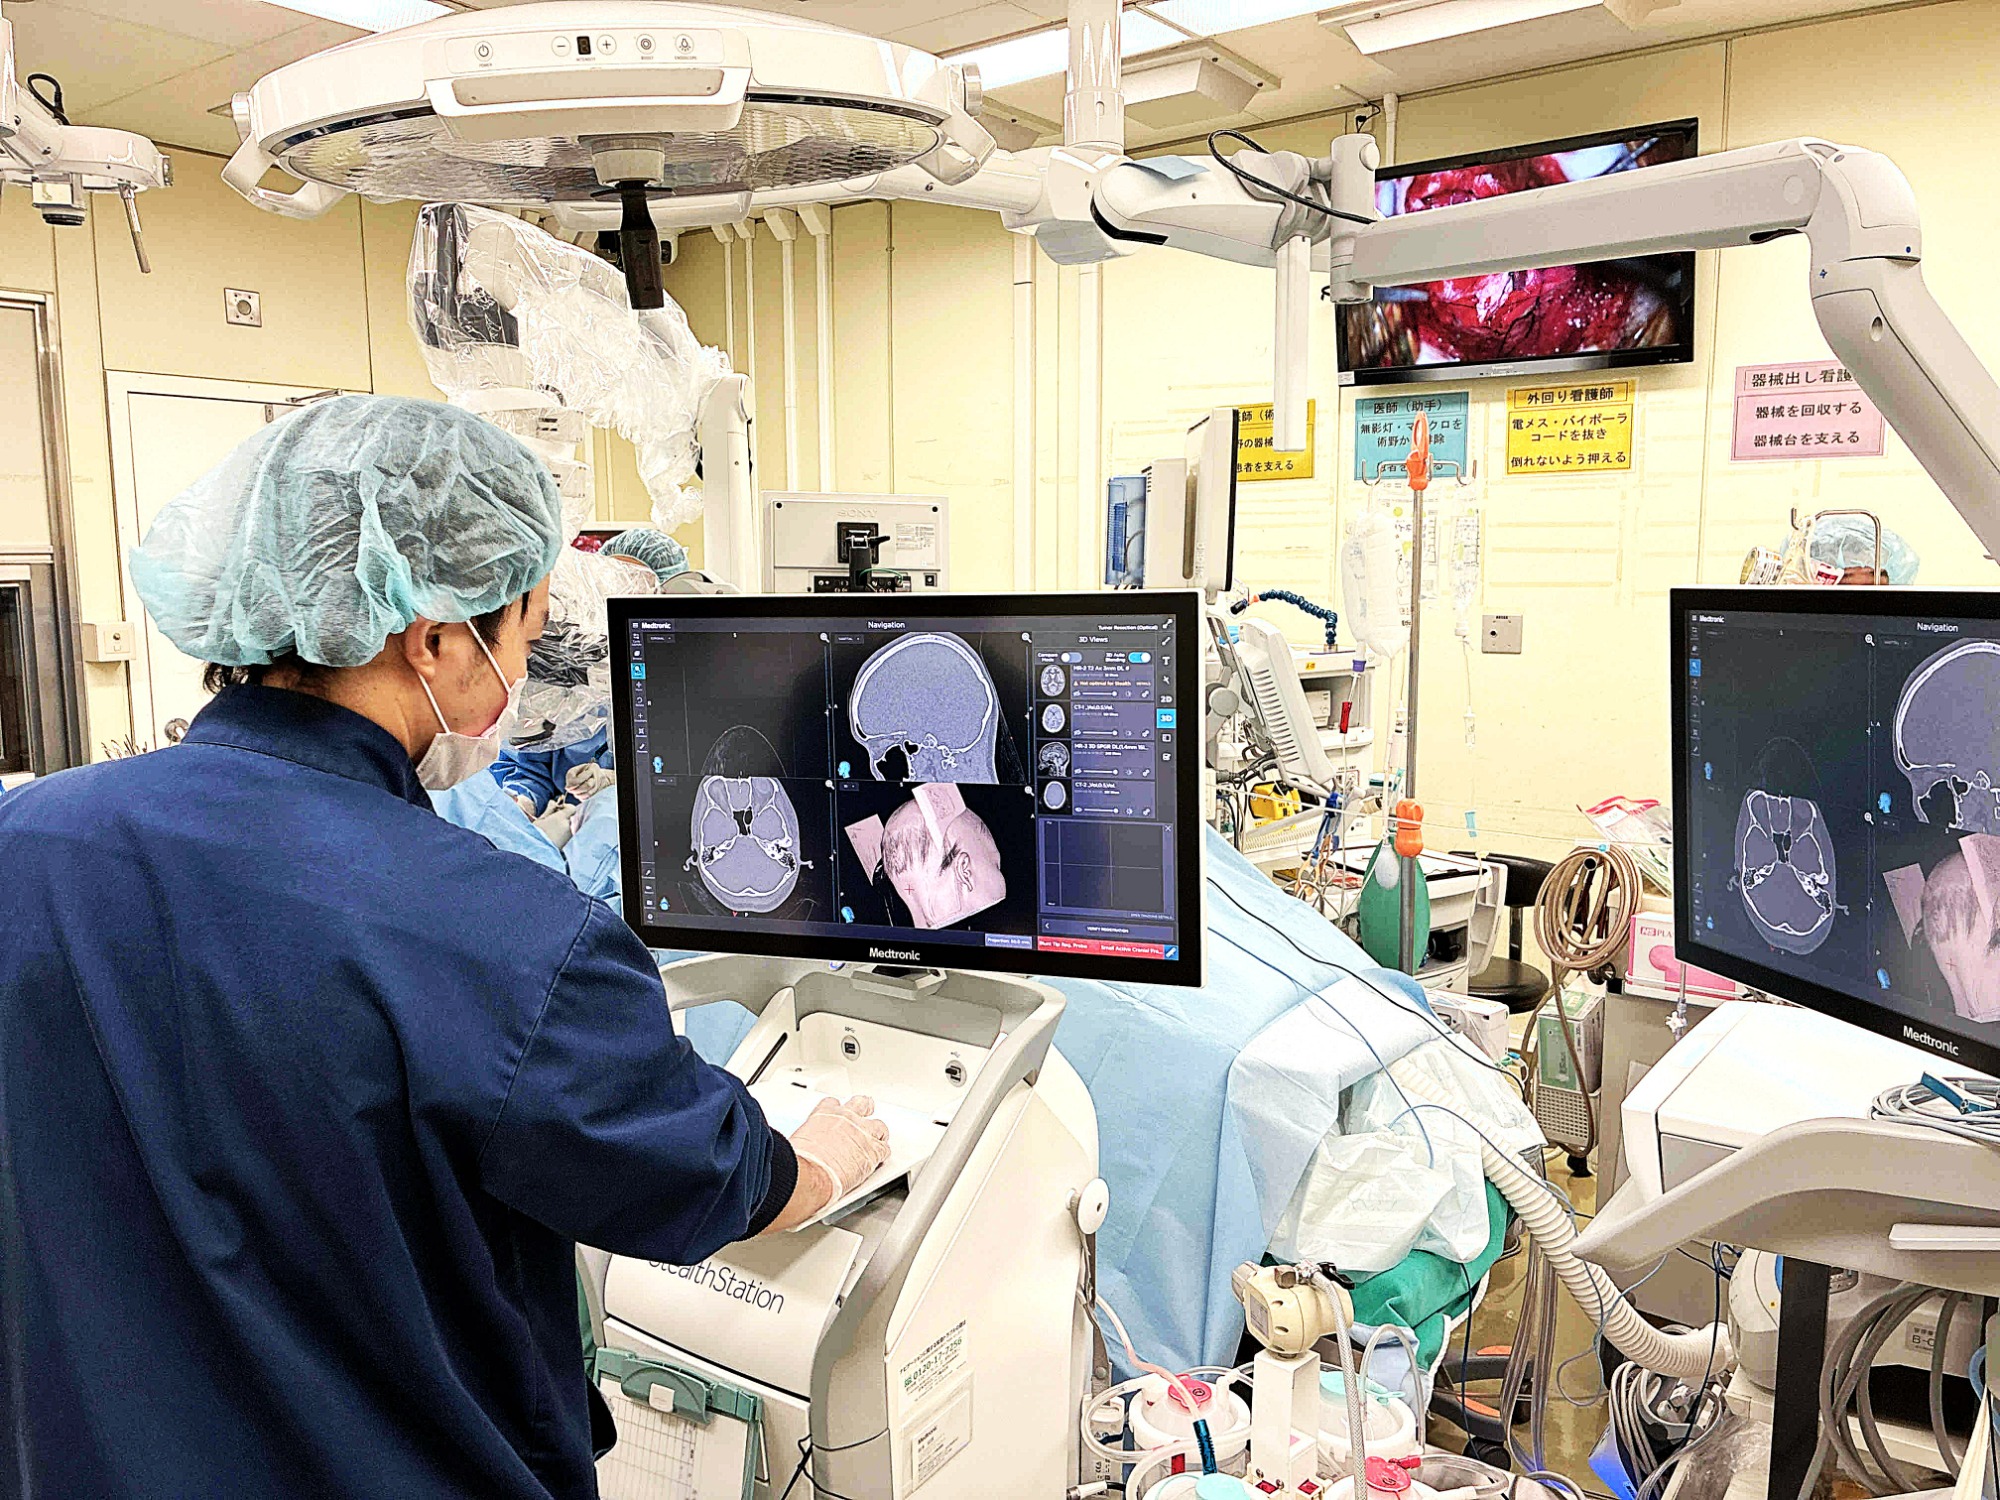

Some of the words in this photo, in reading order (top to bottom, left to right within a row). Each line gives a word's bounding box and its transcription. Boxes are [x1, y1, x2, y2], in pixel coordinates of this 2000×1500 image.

[1528, 387, 1614, 404] 外回り看護師
[1756, 402, 1862, 419] 器械を回収する
[1361, 419, 1462, 434] 無影灯・マクロを
[1532, 428, 1607, 442] コードを抜き
[1754, 431, 1860, 447] 器械台を支える
[1511, 451, 1626, 468] 倒れないよう押える
[837, 508, 878, 517] SONY
[867, 621, 906, 630] Navigation
[1916, 622, 1959, 633] Navigation
[1160, 714, 1173, 722] 3D
[869, 946, 921, 960] Medtronic
[1903, 1025, 1959, 1056] Medtronic
